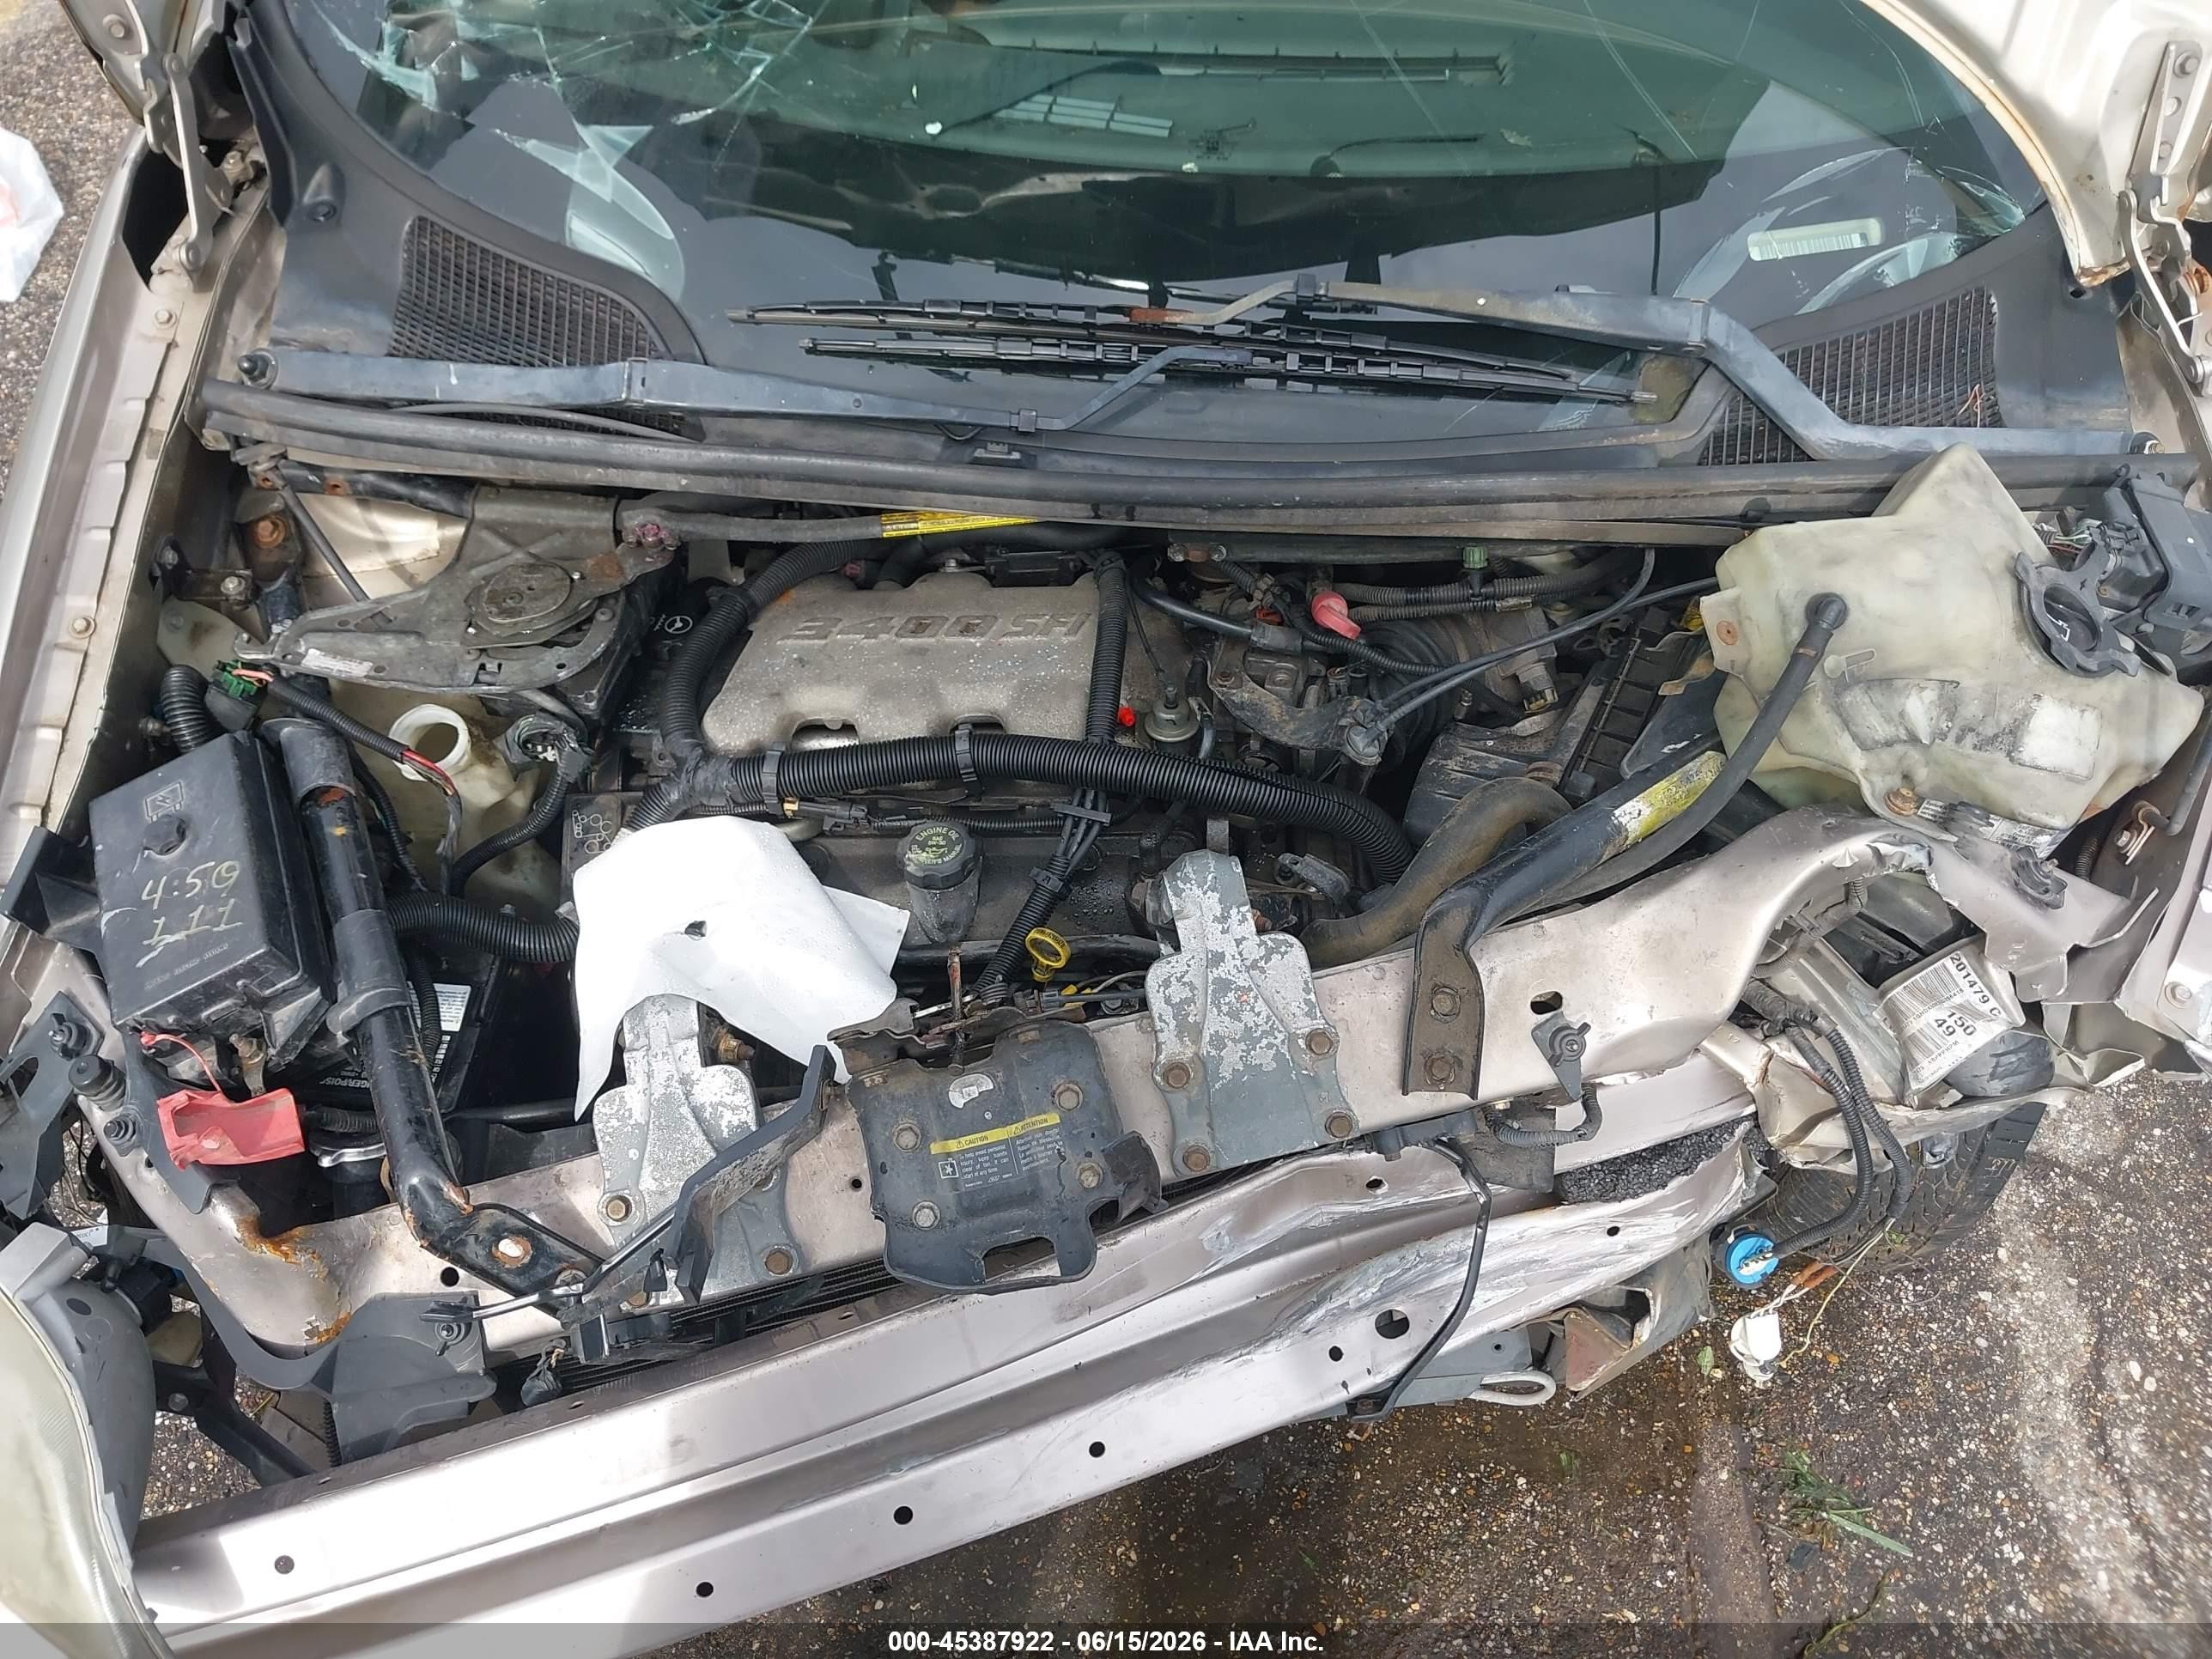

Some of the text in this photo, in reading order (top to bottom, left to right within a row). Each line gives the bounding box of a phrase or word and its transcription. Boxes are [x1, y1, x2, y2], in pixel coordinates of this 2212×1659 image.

[776, 615, 1000, 644] 3400
[915, 827, 960, 841] ENGINE OIL
[943, 843, 962, 862] MANUAL
[1949, 953, 2002, 1017] 201479 C
[1935, 1018, 1956, 1036] 49
[1947, 1011, 1977, 1036] 150
[1021, 1117, 1048, 1132] ATTENTION
[964, 1134, 989, 1145] CAUTION
